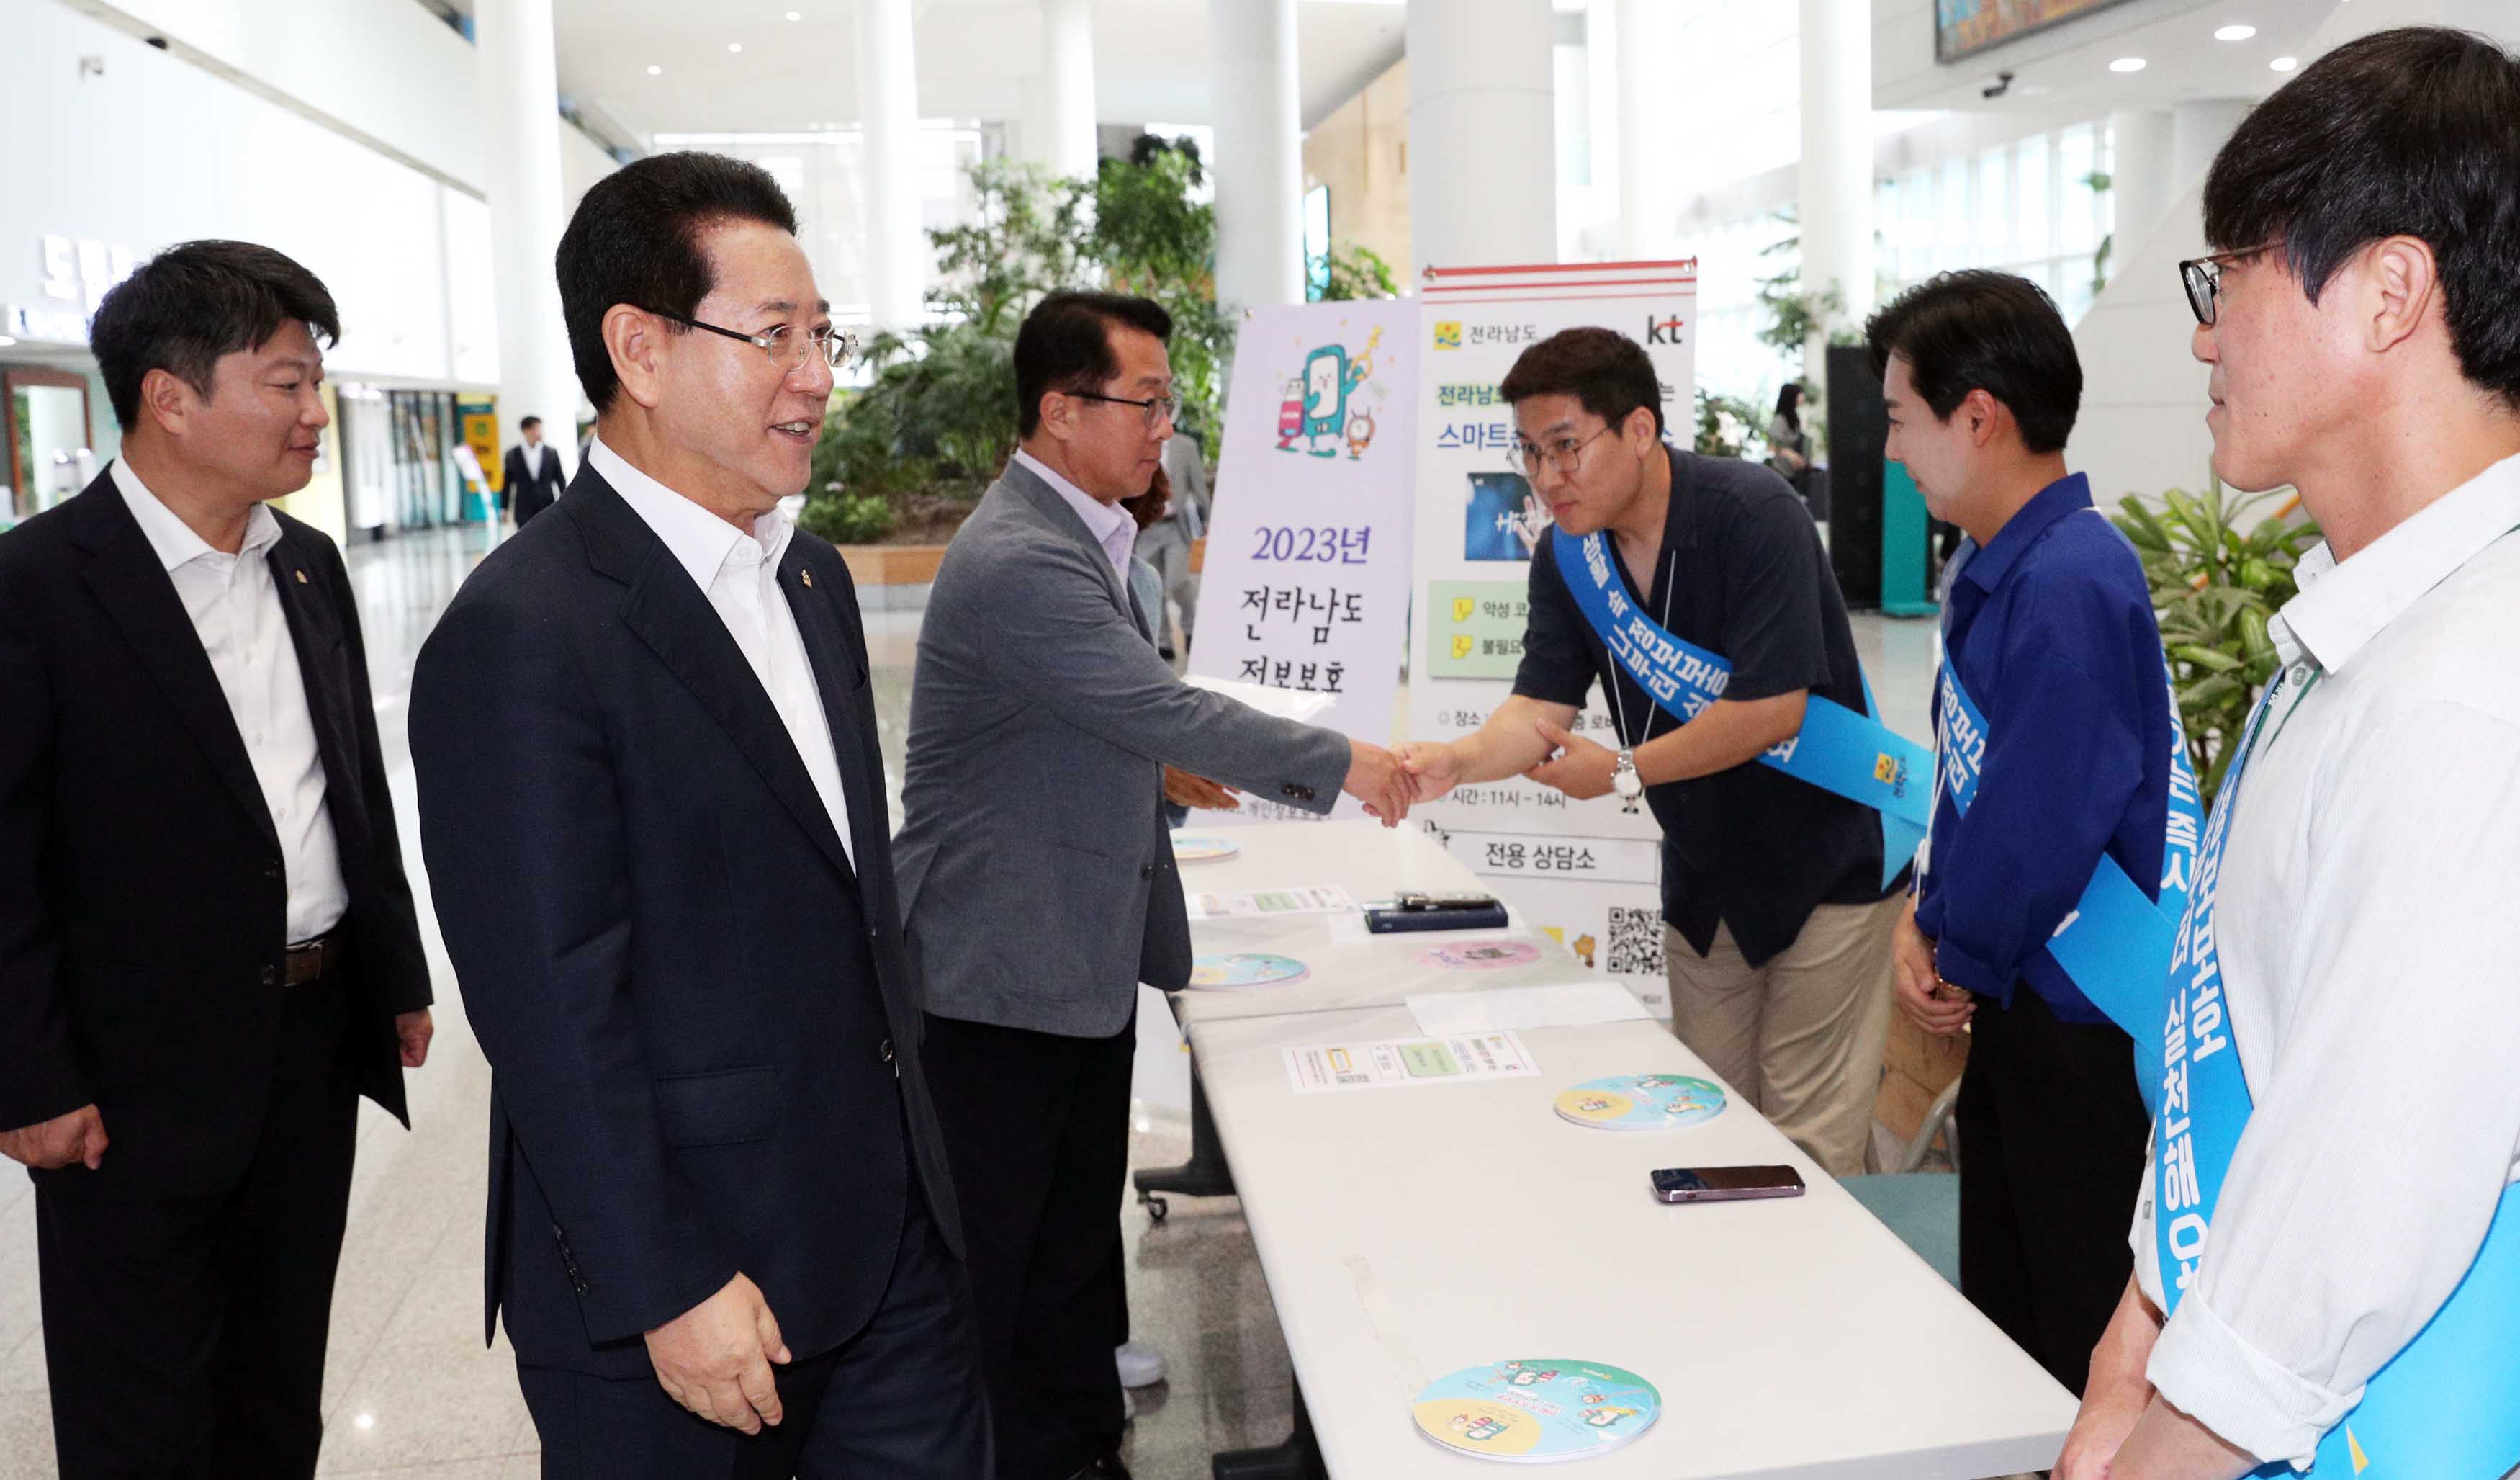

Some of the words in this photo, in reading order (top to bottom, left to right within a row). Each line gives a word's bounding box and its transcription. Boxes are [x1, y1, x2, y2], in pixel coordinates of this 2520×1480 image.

[1469, 324, 1537, 344] 전라남도
[1647, 315, 1683, 346] kt
[1251, 526, 1370, 564] 2023년
[1241, 585, 1362, 645] 전라남도
[1514, 602, 1528, 617] 코
[1454, 710, 1480, 727] 장소
[1452, 789, 1479, 805] 시간
[1490, 790, 1521, 808] 11시
[1537, 791, 1567, 808] 14시
[1486, 842, 1526, 869] 전용
[1533, 845, 1596, 871] 상담소
